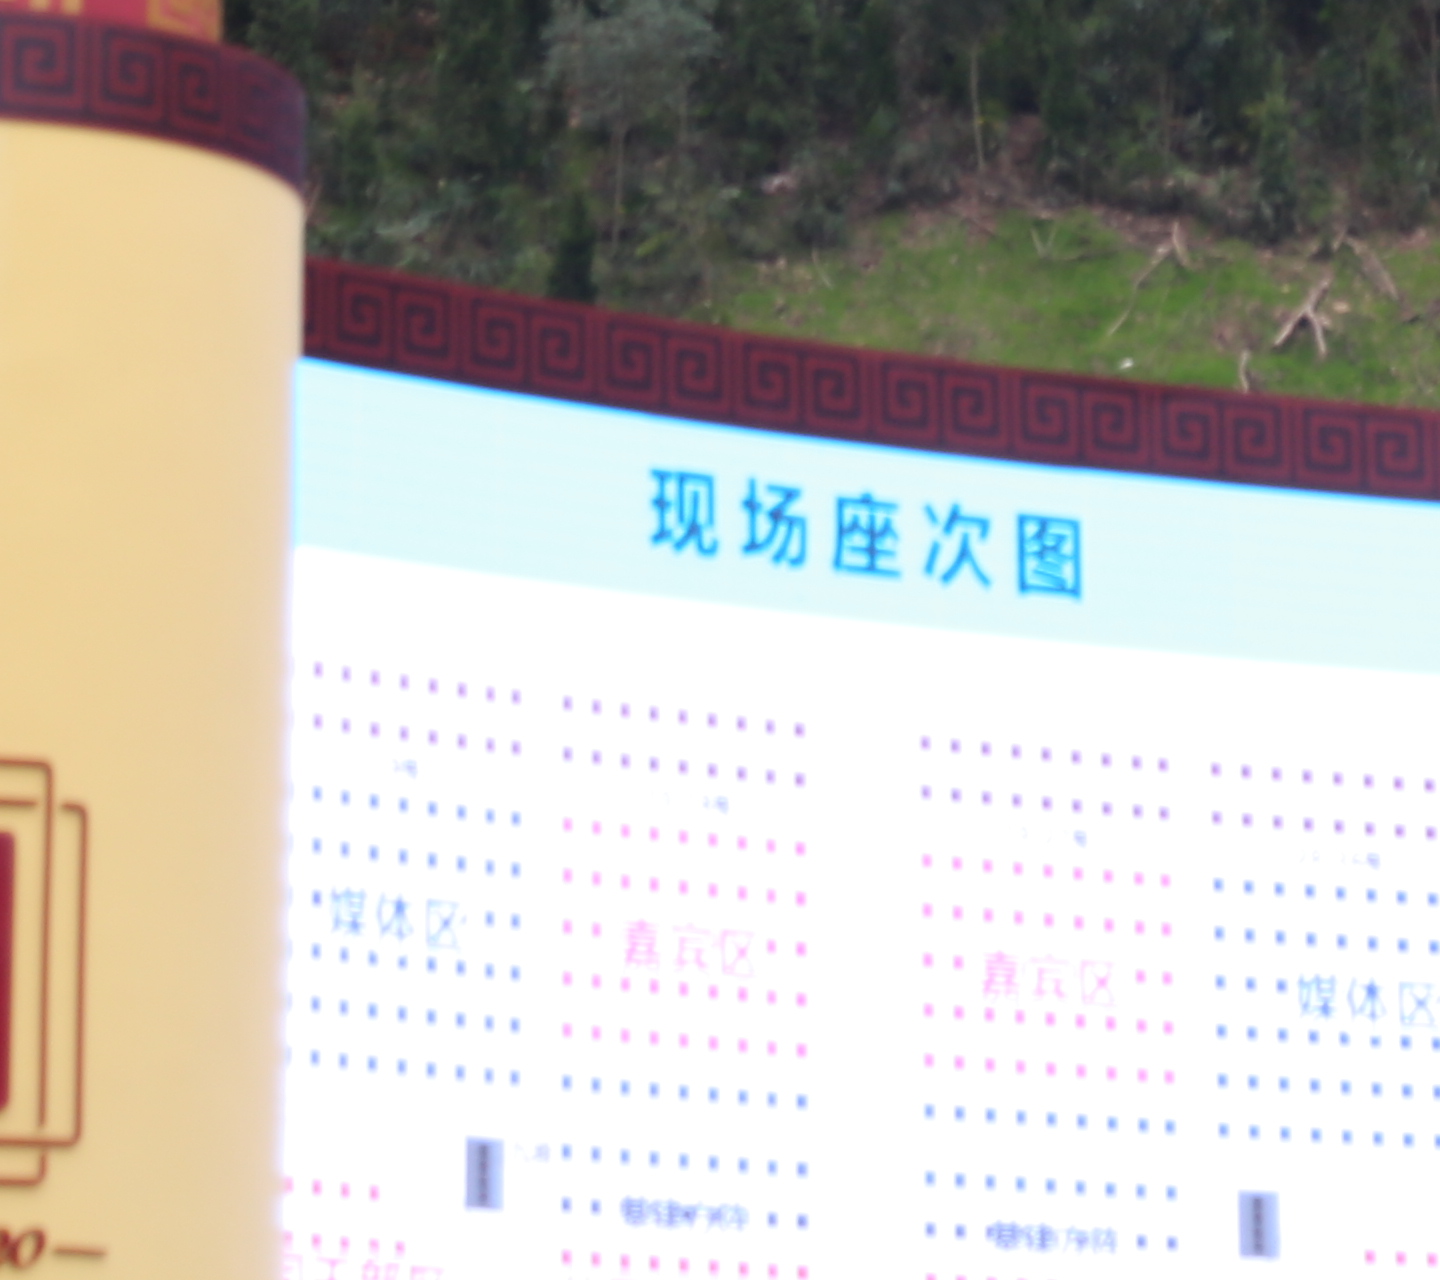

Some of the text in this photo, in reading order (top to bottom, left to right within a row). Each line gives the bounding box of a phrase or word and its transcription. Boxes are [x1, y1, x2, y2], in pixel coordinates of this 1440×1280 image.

[648, 467, 1085, 601] 现场座次图
[326, 885, 462, 951] 媒体区
[1295, 972, 1440, 1030] 媒体区
